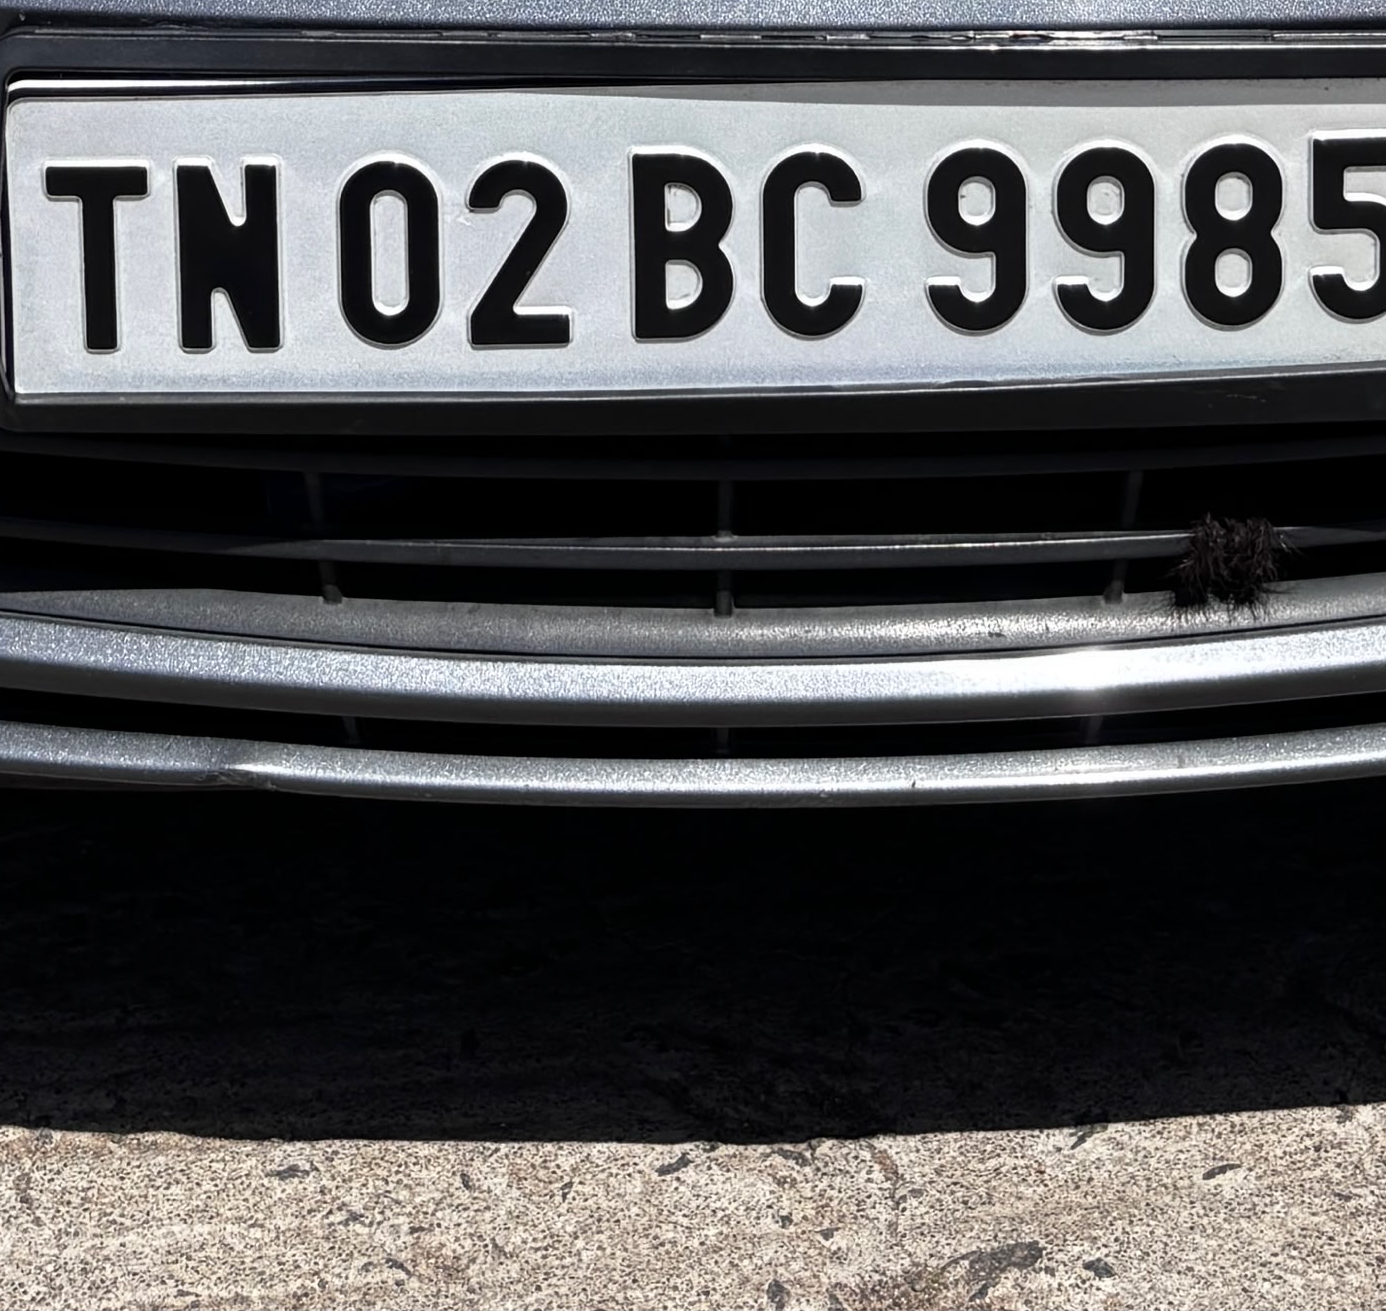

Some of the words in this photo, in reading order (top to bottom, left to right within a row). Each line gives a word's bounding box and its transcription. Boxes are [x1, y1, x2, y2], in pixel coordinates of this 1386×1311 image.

[43, 163, 282, 352] TN
[338, 159, 571, 347] 02
[630, 151, 864, 341] BC
